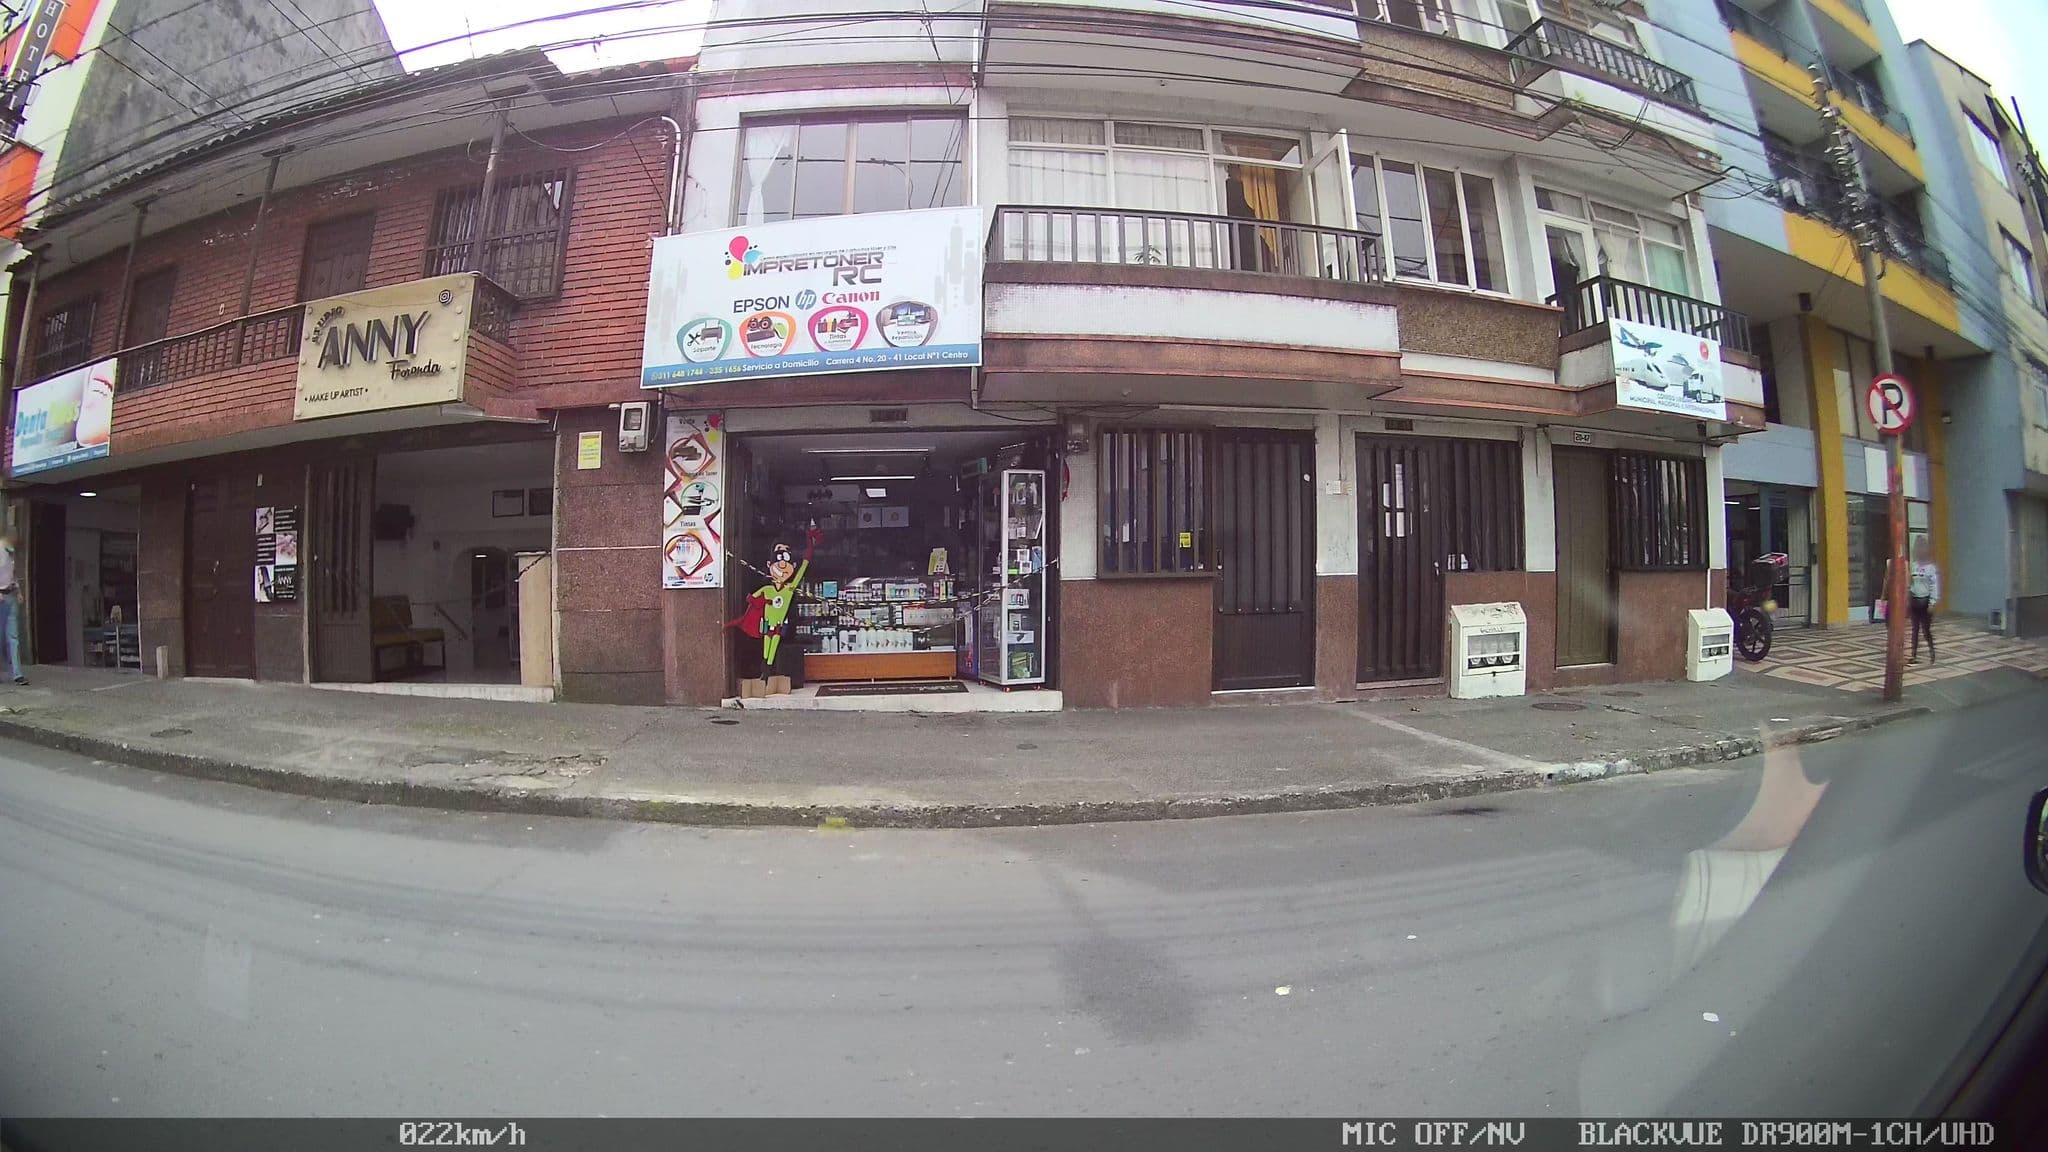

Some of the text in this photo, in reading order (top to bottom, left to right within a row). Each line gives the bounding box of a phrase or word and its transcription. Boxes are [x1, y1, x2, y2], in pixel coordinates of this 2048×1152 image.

[743, 251, 884, 276] IMPRETONER
[833, 264, 882, 286] RC
[733, 295, 790, 313] EPSON
[796, 289, 817, 310] hp
[822, 291, 880, 304] Canon
[317, 311, 430, 369] ANNY
[941, 351, 969, 359] Centro
[742, 363, 773, 371] Servicio
[782, 359, 819, 368] Domicilio
[309, 387, 364, 402] MAKE UP ARTIST
[1880, 383, 1903, 424] P
